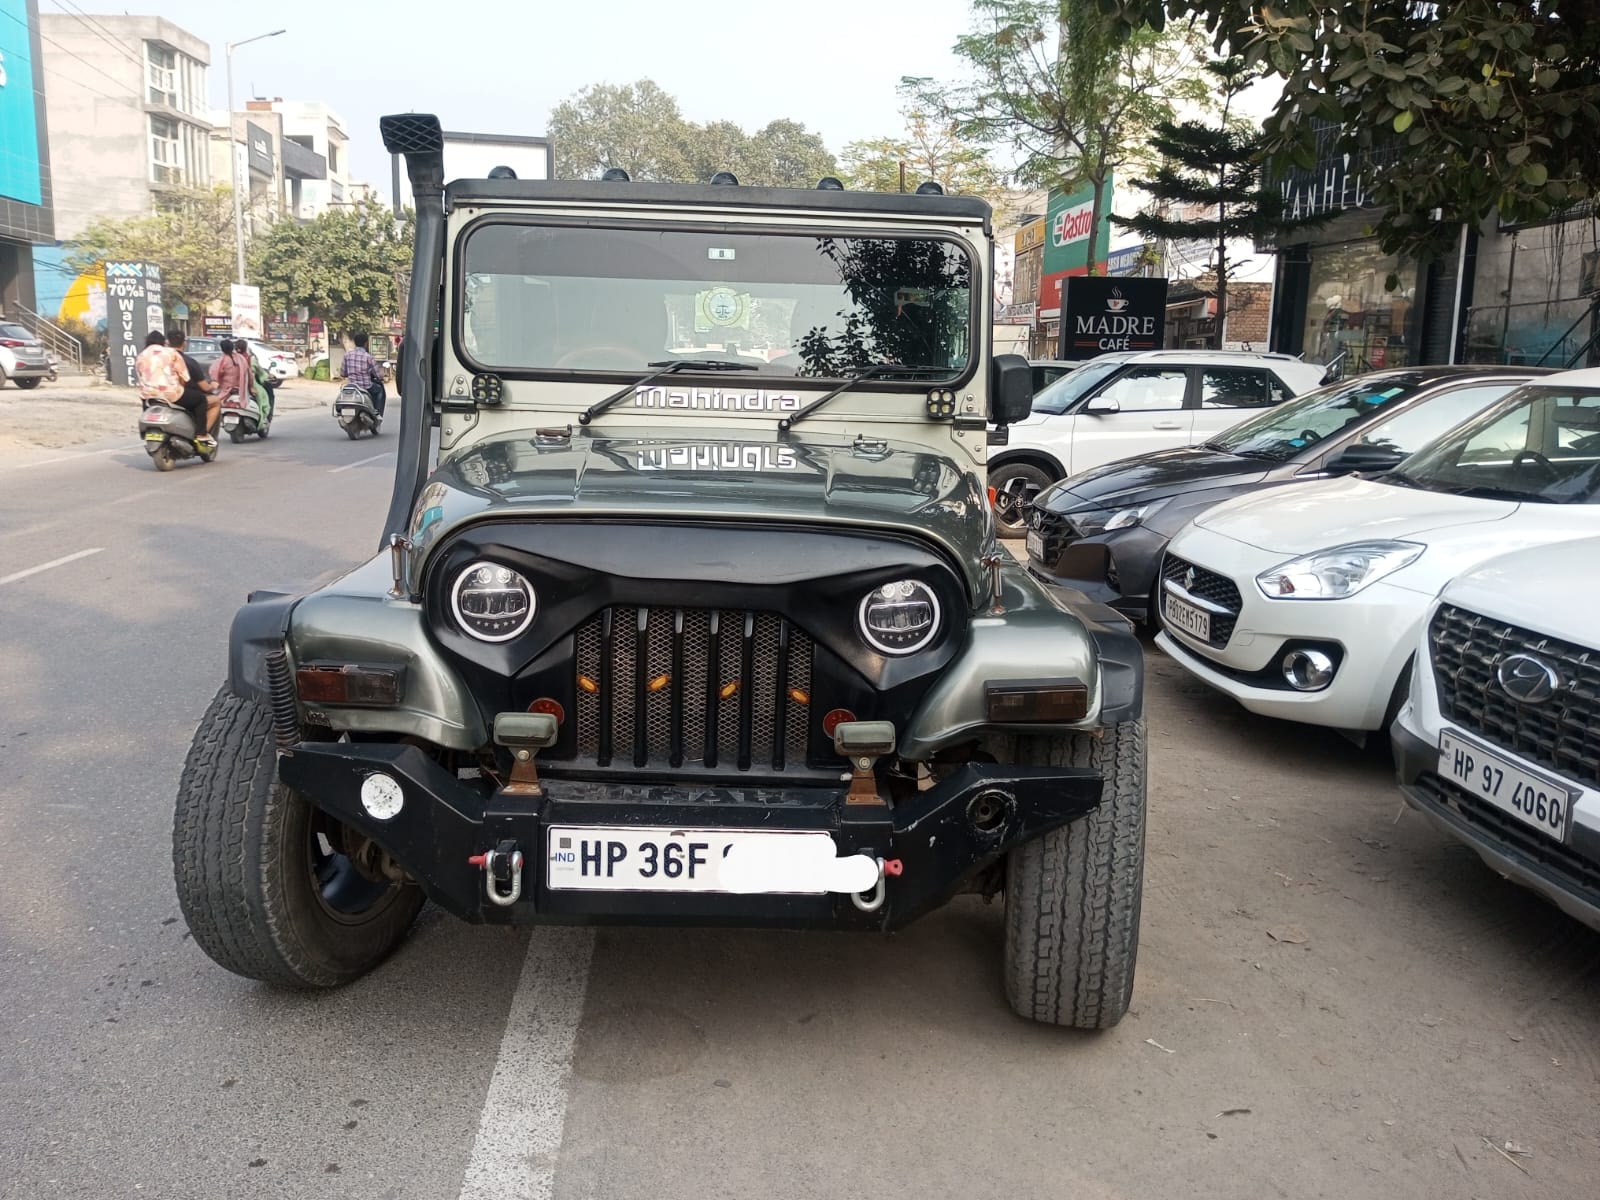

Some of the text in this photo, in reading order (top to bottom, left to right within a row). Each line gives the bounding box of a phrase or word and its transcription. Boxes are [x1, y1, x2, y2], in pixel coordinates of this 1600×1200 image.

[1063, 208, 1092, 241] Castro
[1075, 316, 1155, 335] MADRE
[1098, 336, 1130, 350] CAFÉ
[1454, 748, 1560, 828] HP 97 4060
[554, 852, 575, 862] IND
[581, 840, 627, 878] HP
[638, 842, 709, 879] 36F
